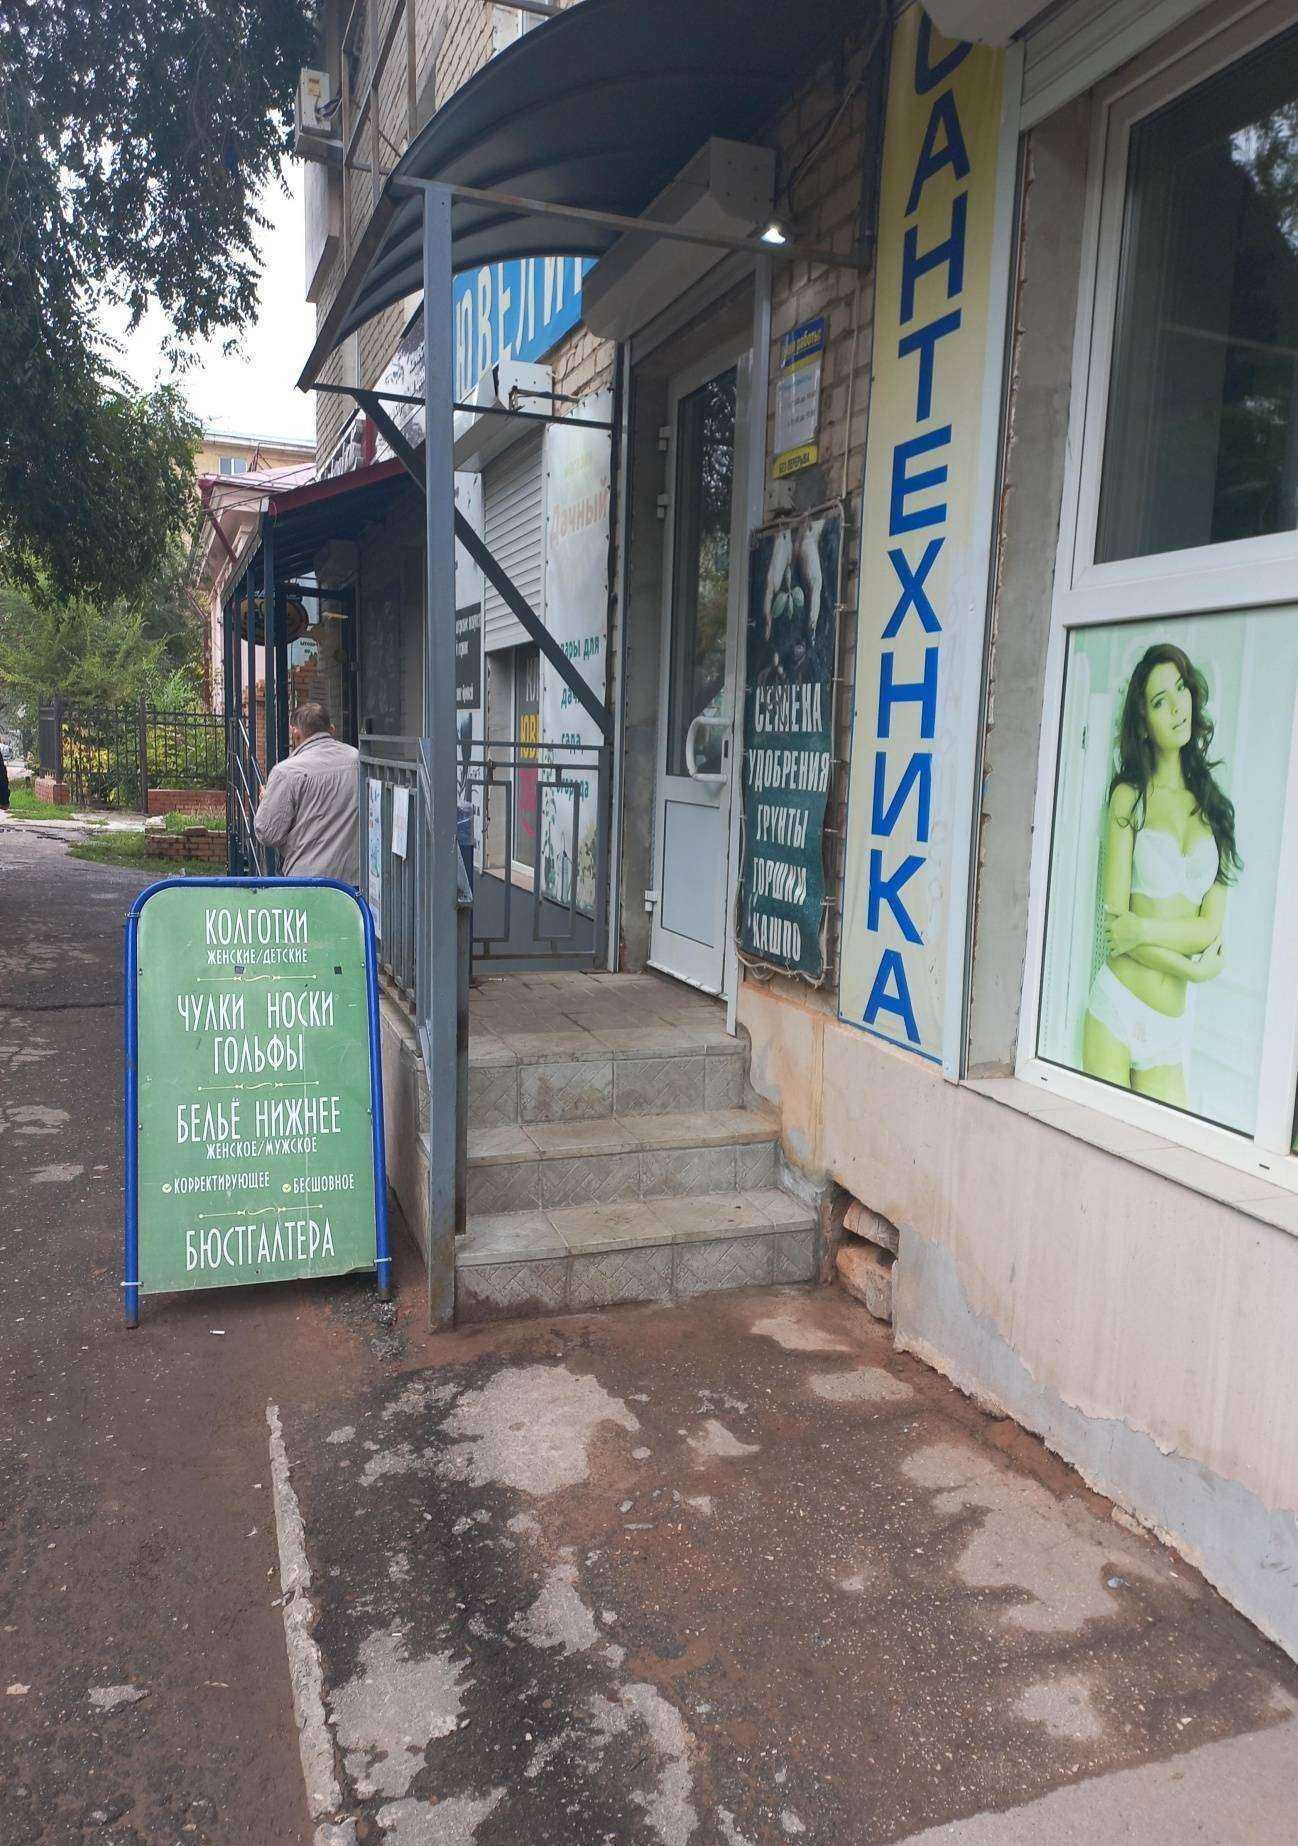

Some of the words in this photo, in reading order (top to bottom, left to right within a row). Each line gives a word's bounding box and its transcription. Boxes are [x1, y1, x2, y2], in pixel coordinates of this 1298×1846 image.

[755, 682, 823, 733] СЕМЕНА
[749, 749, 830, 793] УДОБРЕНИЯ
[756, 804, 809, 849] ГРУНТЫ
[752, 857, 807, 905] ГОРШКИ
[205, 908, 309, 945] КОЛГОТКИ
[752, 912, 801, 961] КАШПО
[207, 947, 309, 965] ЖЕНСКИЕ/ДЕТСКИЕ
[177, 993, 246, 1032] ЧУЛКИ
[266, 990, 335, 1030] НОСКИ
[213, 1033, 304, 1075] ГОЛЬФЫ
[176, 1097, 242, 1144] БЕЛЬЁ
[256, 1096, 341, 1138] НИЖНЕЕ
[207, 1138, 318, 1159] ЖЕНСКОЕ/МУЖСКОЕ
[173, 1172, 271, 1194] КОРРЕКТИРУЮЩЕЕ
[293, 1174, 355, 1194] БЕСШОВНОЕ
[185, 1216, 335, 1272] БЮСТГАЛТЕРА
